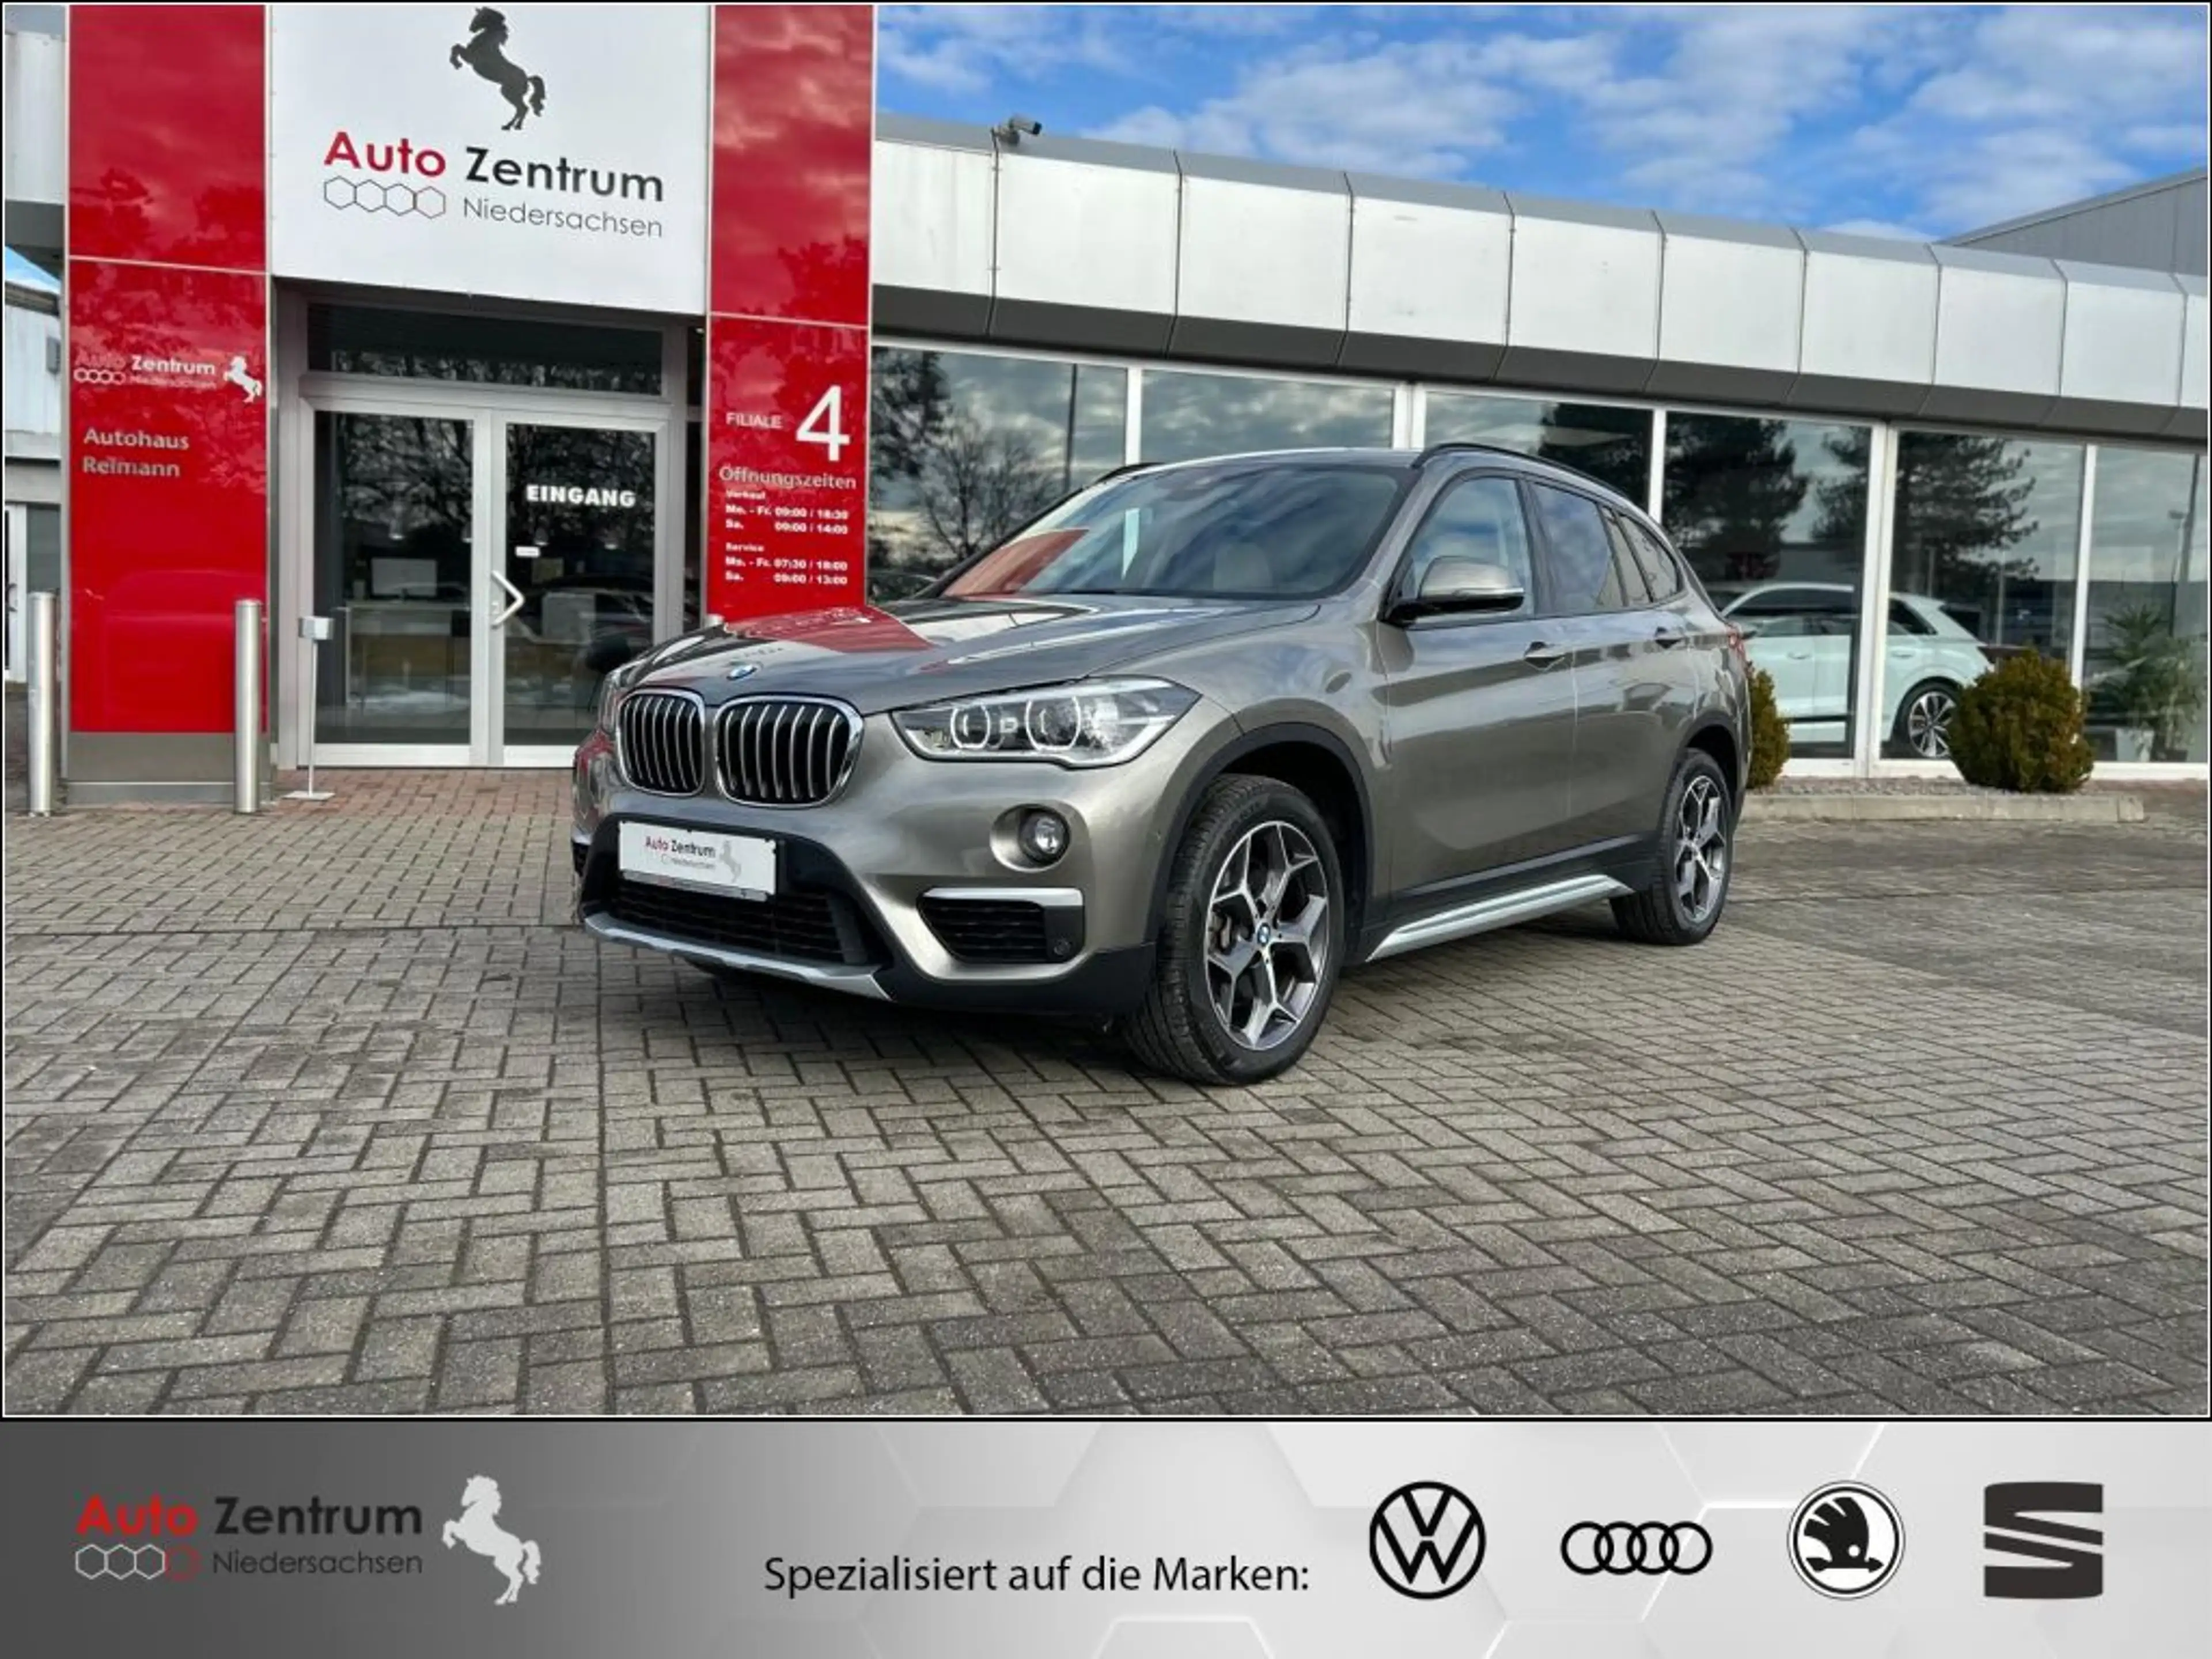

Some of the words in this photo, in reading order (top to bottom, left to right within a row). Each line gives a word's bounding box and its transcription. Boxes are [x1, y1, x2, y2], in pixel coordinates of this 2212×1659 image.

[324, 132, 446, 177] Auto
[465, 146, 664, 202] Zentrum
[463, 198, 662, 237] Niedersachsen
[131, 354, 215, 375] Zentrum
[726, 412, 783, 429] FILIALE
[796, 385, 851, 461] 4
[84, 428, 189, 450] Autohaus
[82, 456, 180, 477] Reimann
[720, 463, 856, 490] Öffnungszeiten
[526, 484, 635, 508] EINGANG
[645, 836, 668, 851] Auto
[671, 839, 716, 857] Zentrum
